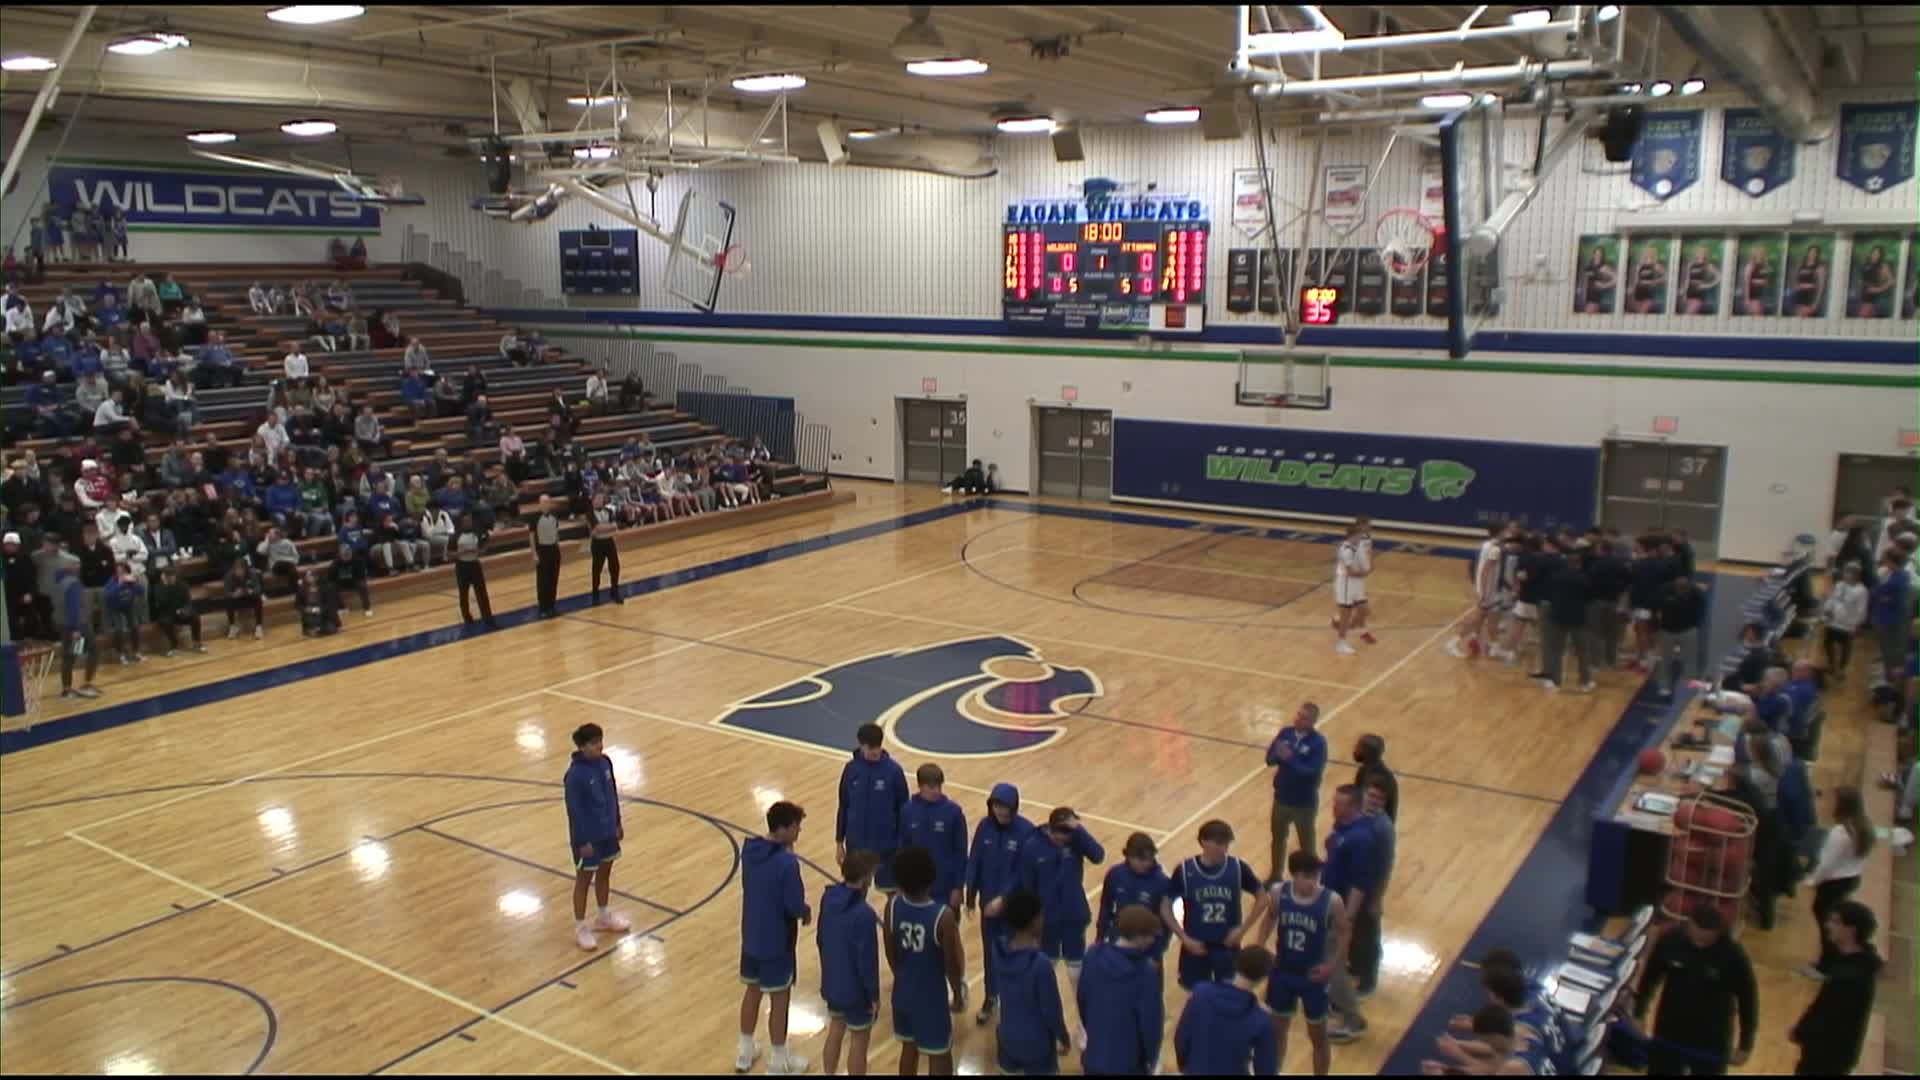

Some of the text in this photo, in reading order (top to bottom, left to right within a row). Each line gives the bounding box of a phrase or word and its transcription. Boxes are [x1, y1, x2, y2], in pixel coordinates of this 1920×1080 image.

[75, 179, 363, 218] WILDCATS
[1006, 200, 1202, 223] EAGAN WILDCATS
[1084, 223, 1123, 241] 18:00
[1063, 253, 1073, 272] 0
[1142, 253, 1153, 271] 0
[1053, 277, 1062, 292] 0
[1069, 277, 1078, 293] 5
[1121, 278, 1132, 294] 5
[1143, 278, 1152, 293] 0
[1308, 301, 1330, 322] 35
[950, 411, 965, 425] 35
[1092, 420, 1110, 435] 36
[1206, 454, 1417, 495] WILDCATS
[1680, 456, 1708, 475] 37
[1195, 886, 1233, 902] EAGAN
[1202, 903, 1226, 923] 22
[899, 921, 925, 952] 33
[1287, 930, 1306, 951] 12
